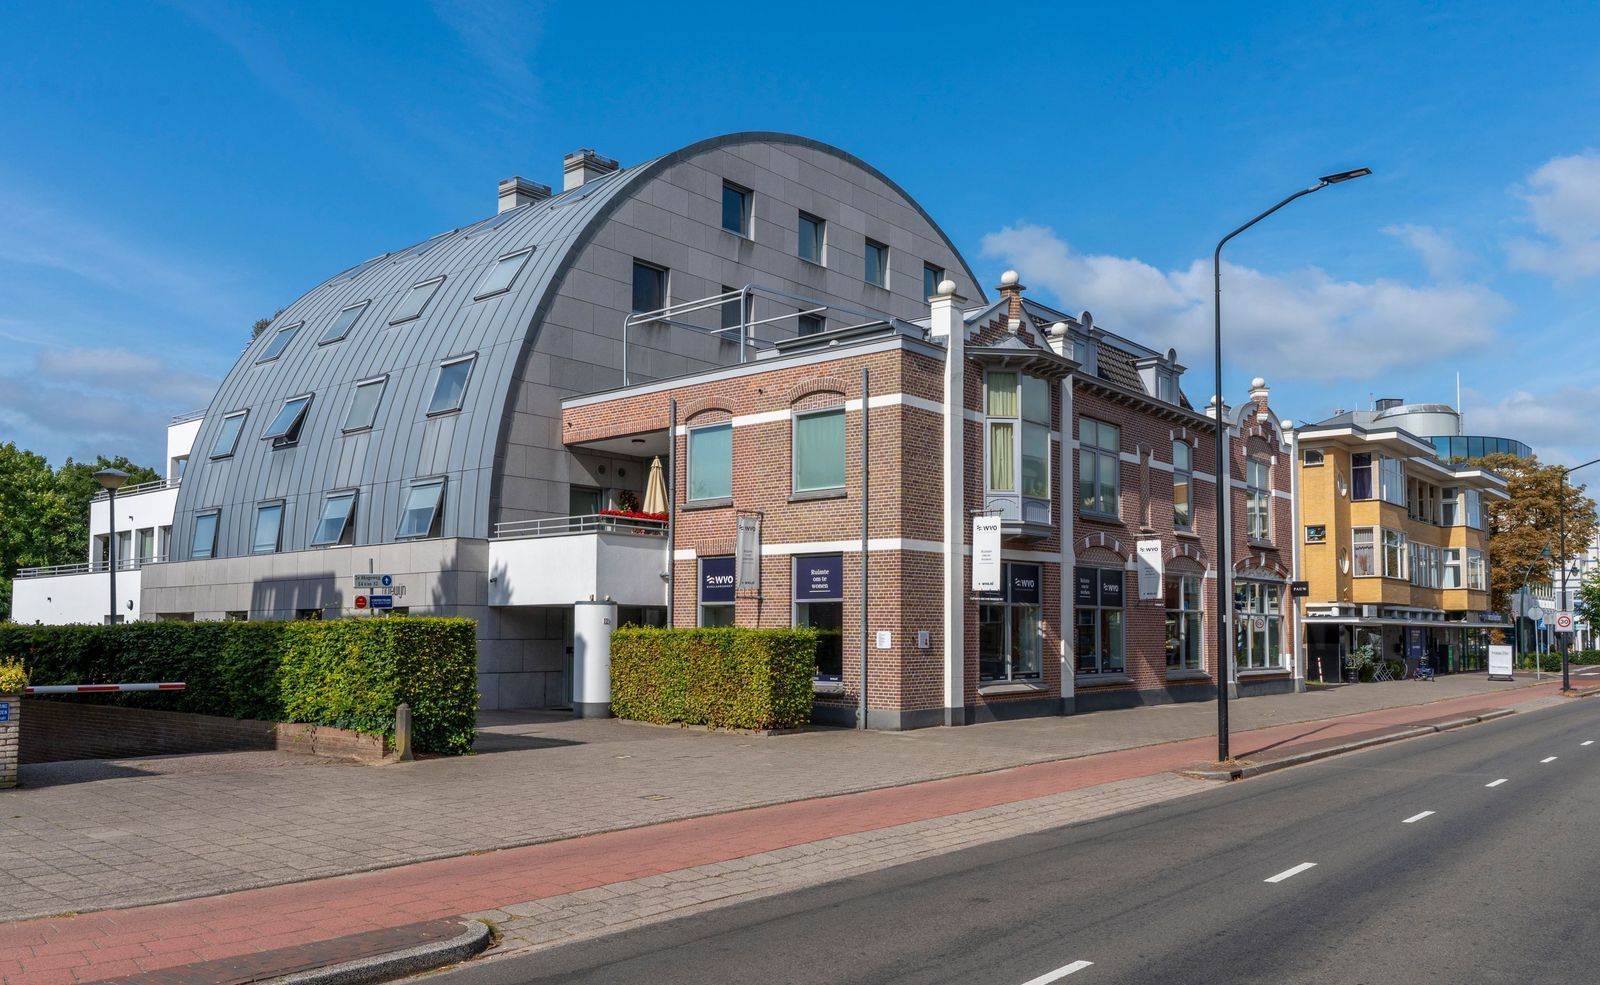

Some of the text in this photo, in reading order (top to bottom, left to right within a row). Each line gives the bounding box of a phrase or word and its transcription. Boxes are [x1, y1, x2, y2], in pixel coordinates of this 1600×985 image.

[715, 575, 734, 584] WVO
[1021, 579, 1035, 588] WVO
[1108, 584, 1119, 592] WVO
